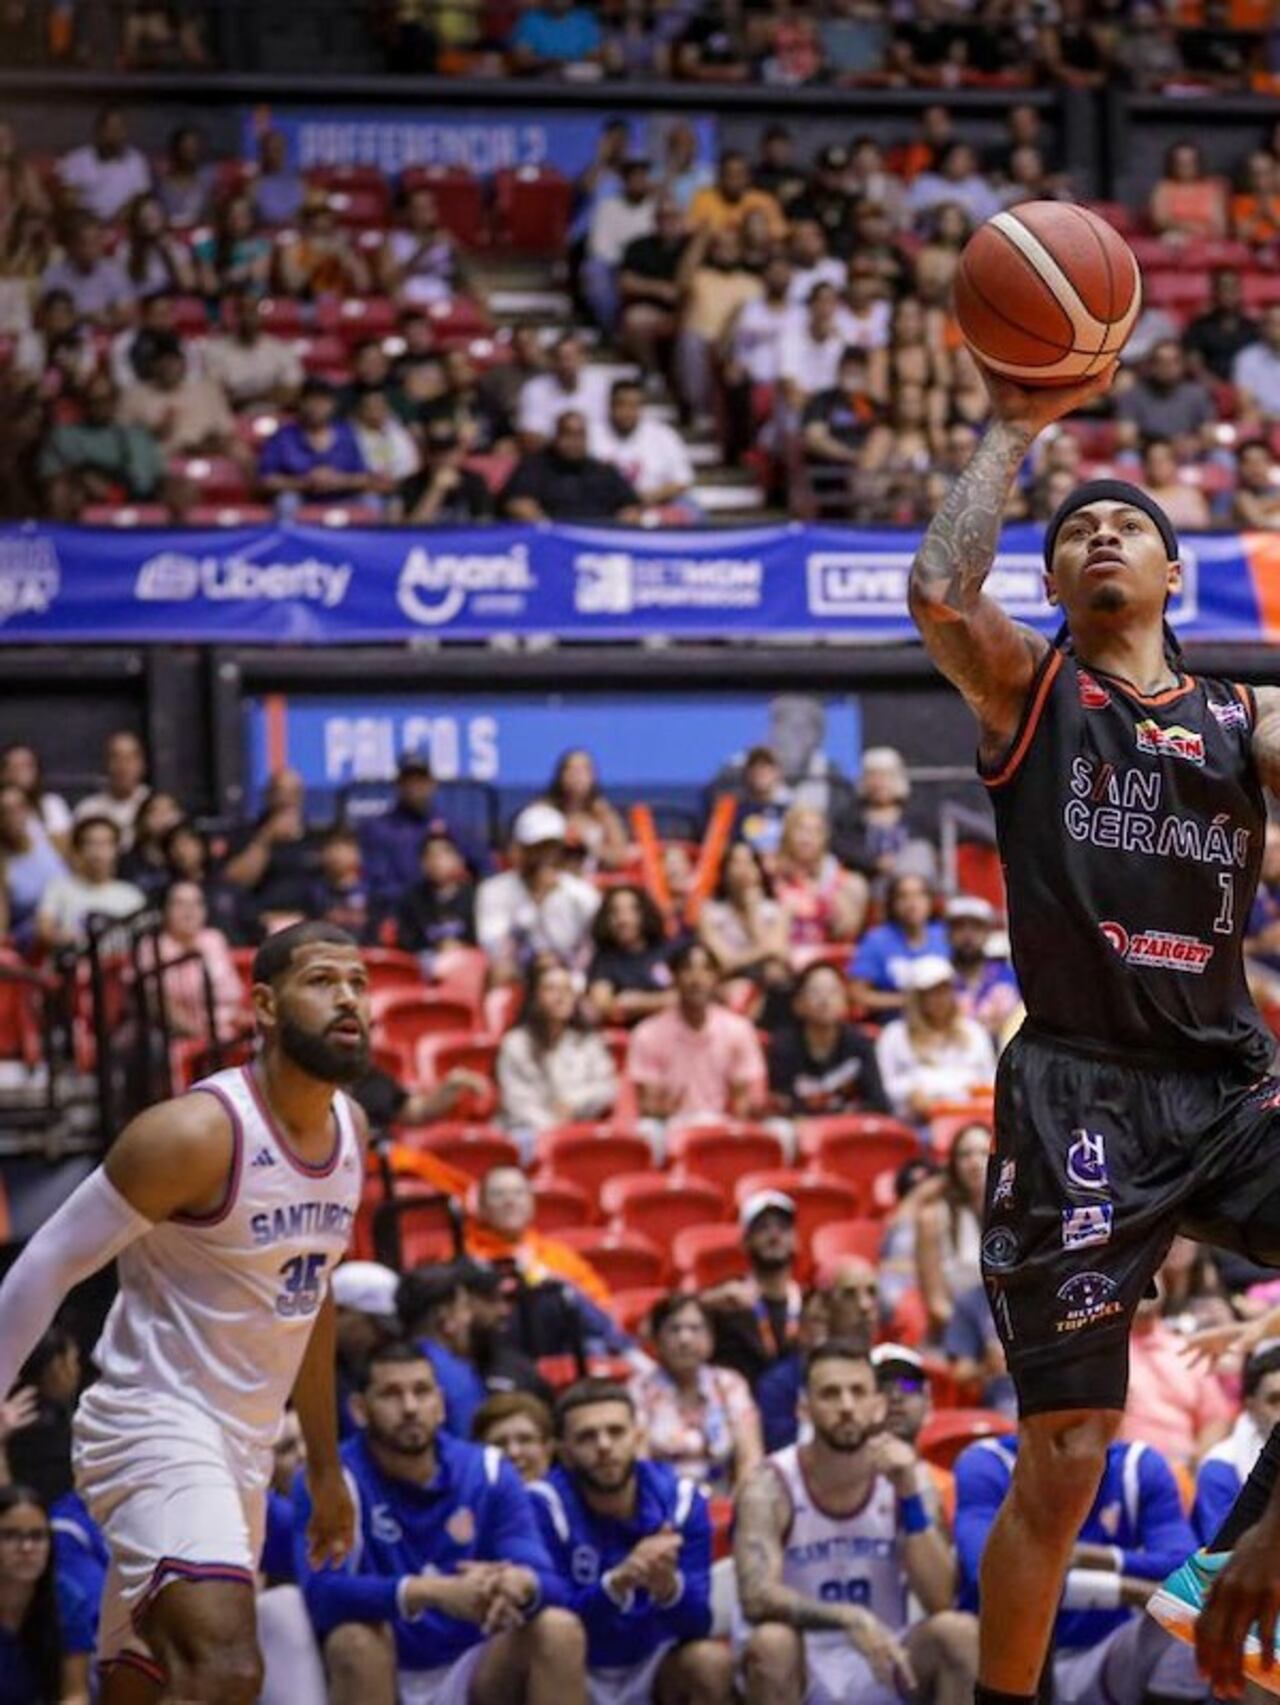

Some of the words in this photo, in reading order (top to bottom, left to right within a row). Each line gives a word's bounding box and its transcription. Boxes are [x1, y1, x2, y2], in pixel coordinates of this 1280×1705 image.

[201, 555, 353, 607] Liberty
[468, 715, 501, 781] S
[1069, 756, 1162, 812] SAN
[1213, 872, 1235, 935] 1
[1130, 936, 1213, 965] TARGET
[275, 1251, 328, 1318] 35
